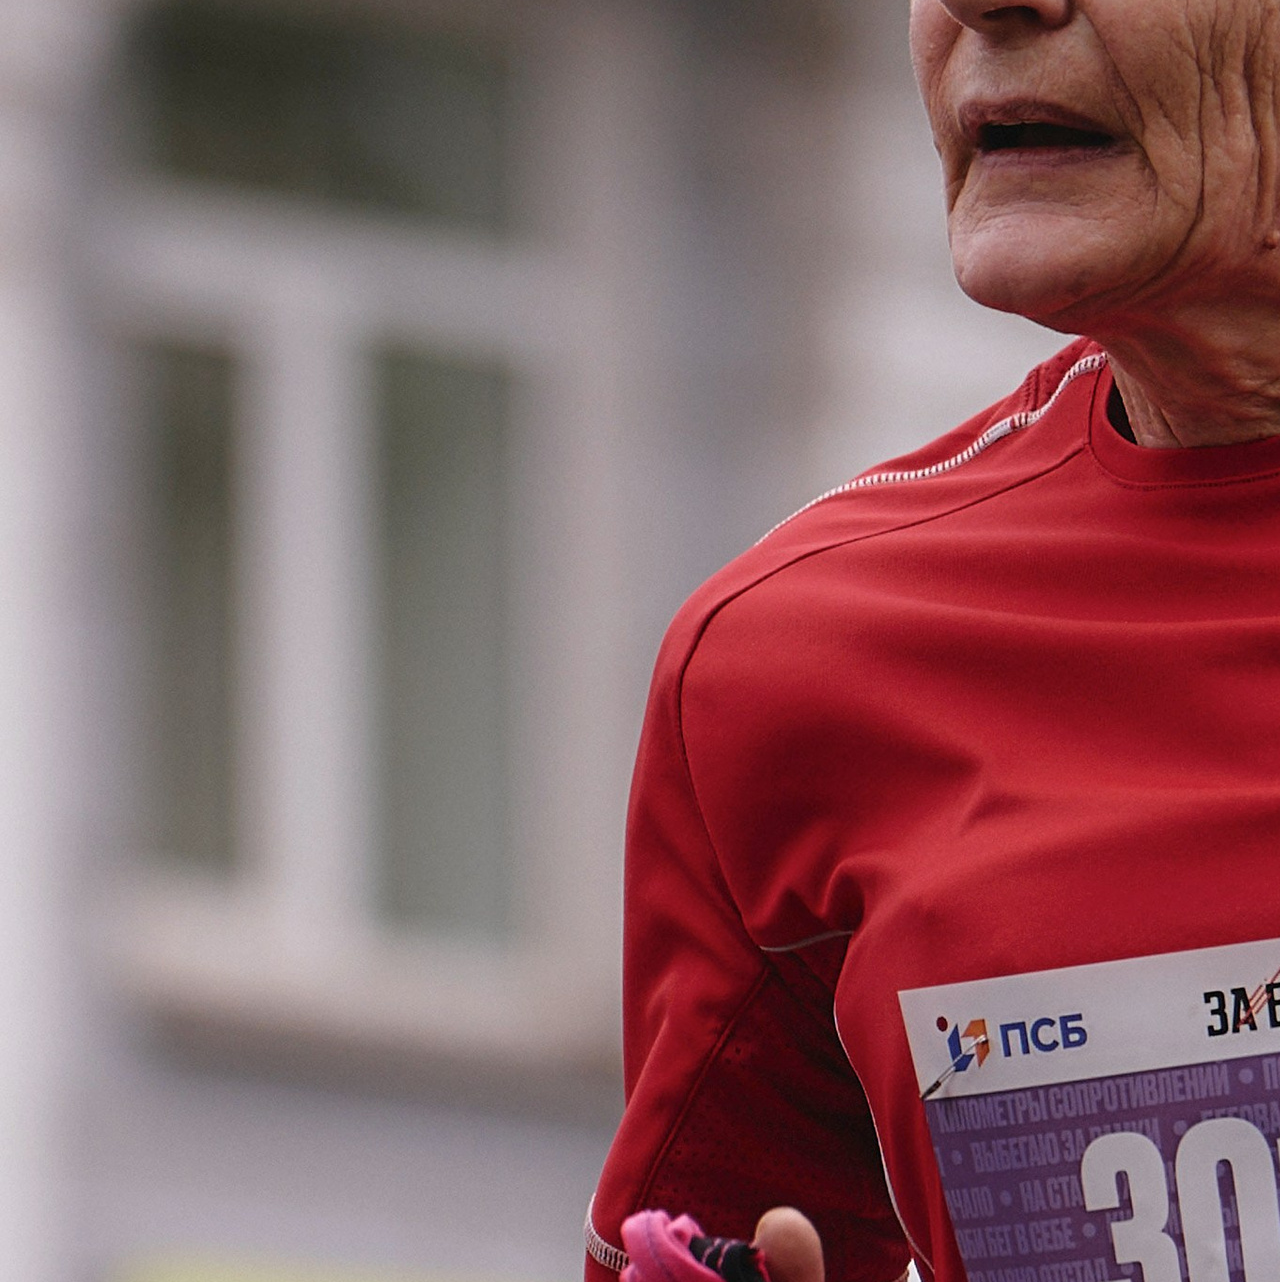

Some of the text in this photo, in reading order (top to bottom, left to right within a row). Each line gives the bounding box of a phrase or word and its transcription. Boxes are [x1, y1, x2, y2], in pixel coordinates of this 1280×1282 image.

[1000, 1013, 1088, 1058] ПСБ
[970, 1131, 1060, 1172] ВЫБЕГАЮ
[1018, 1179, 1047, 1212] НА
